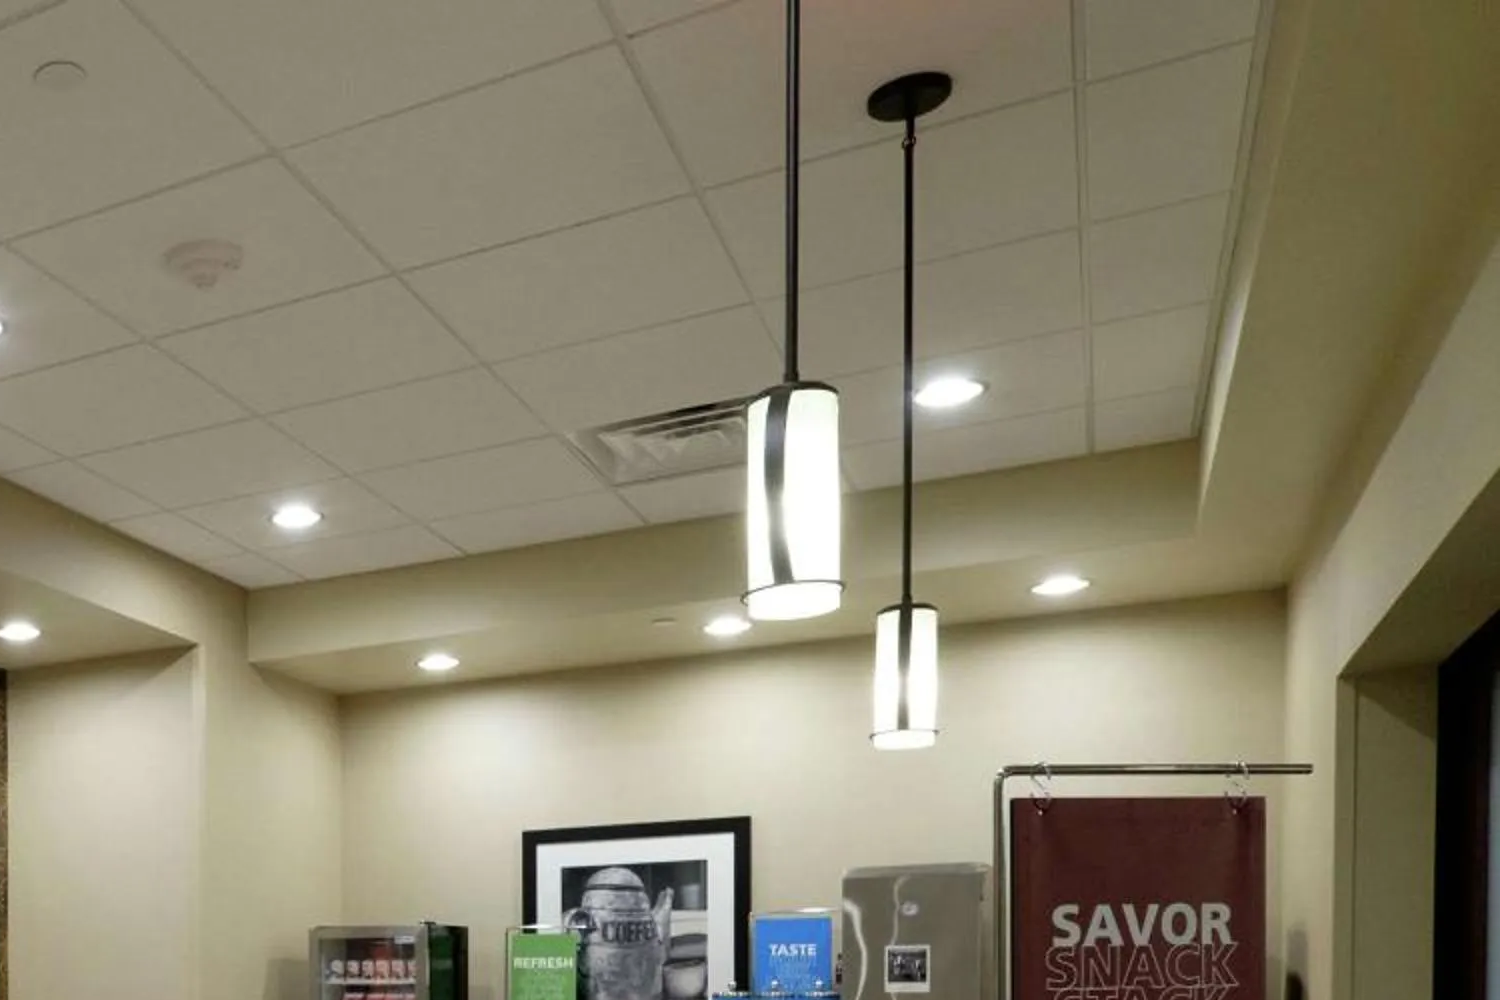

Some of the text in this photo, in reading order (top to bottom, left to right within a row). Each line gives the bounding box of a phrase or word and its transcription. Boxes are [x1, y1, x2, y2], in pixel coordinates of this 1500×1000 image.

[1051, 903, 1233, 947] SAVOR
[513, 956, 573, 969] REFRESH
[769, 943, 817, 956] TASTE
[1045, 942, 1239, 990] SNACK
